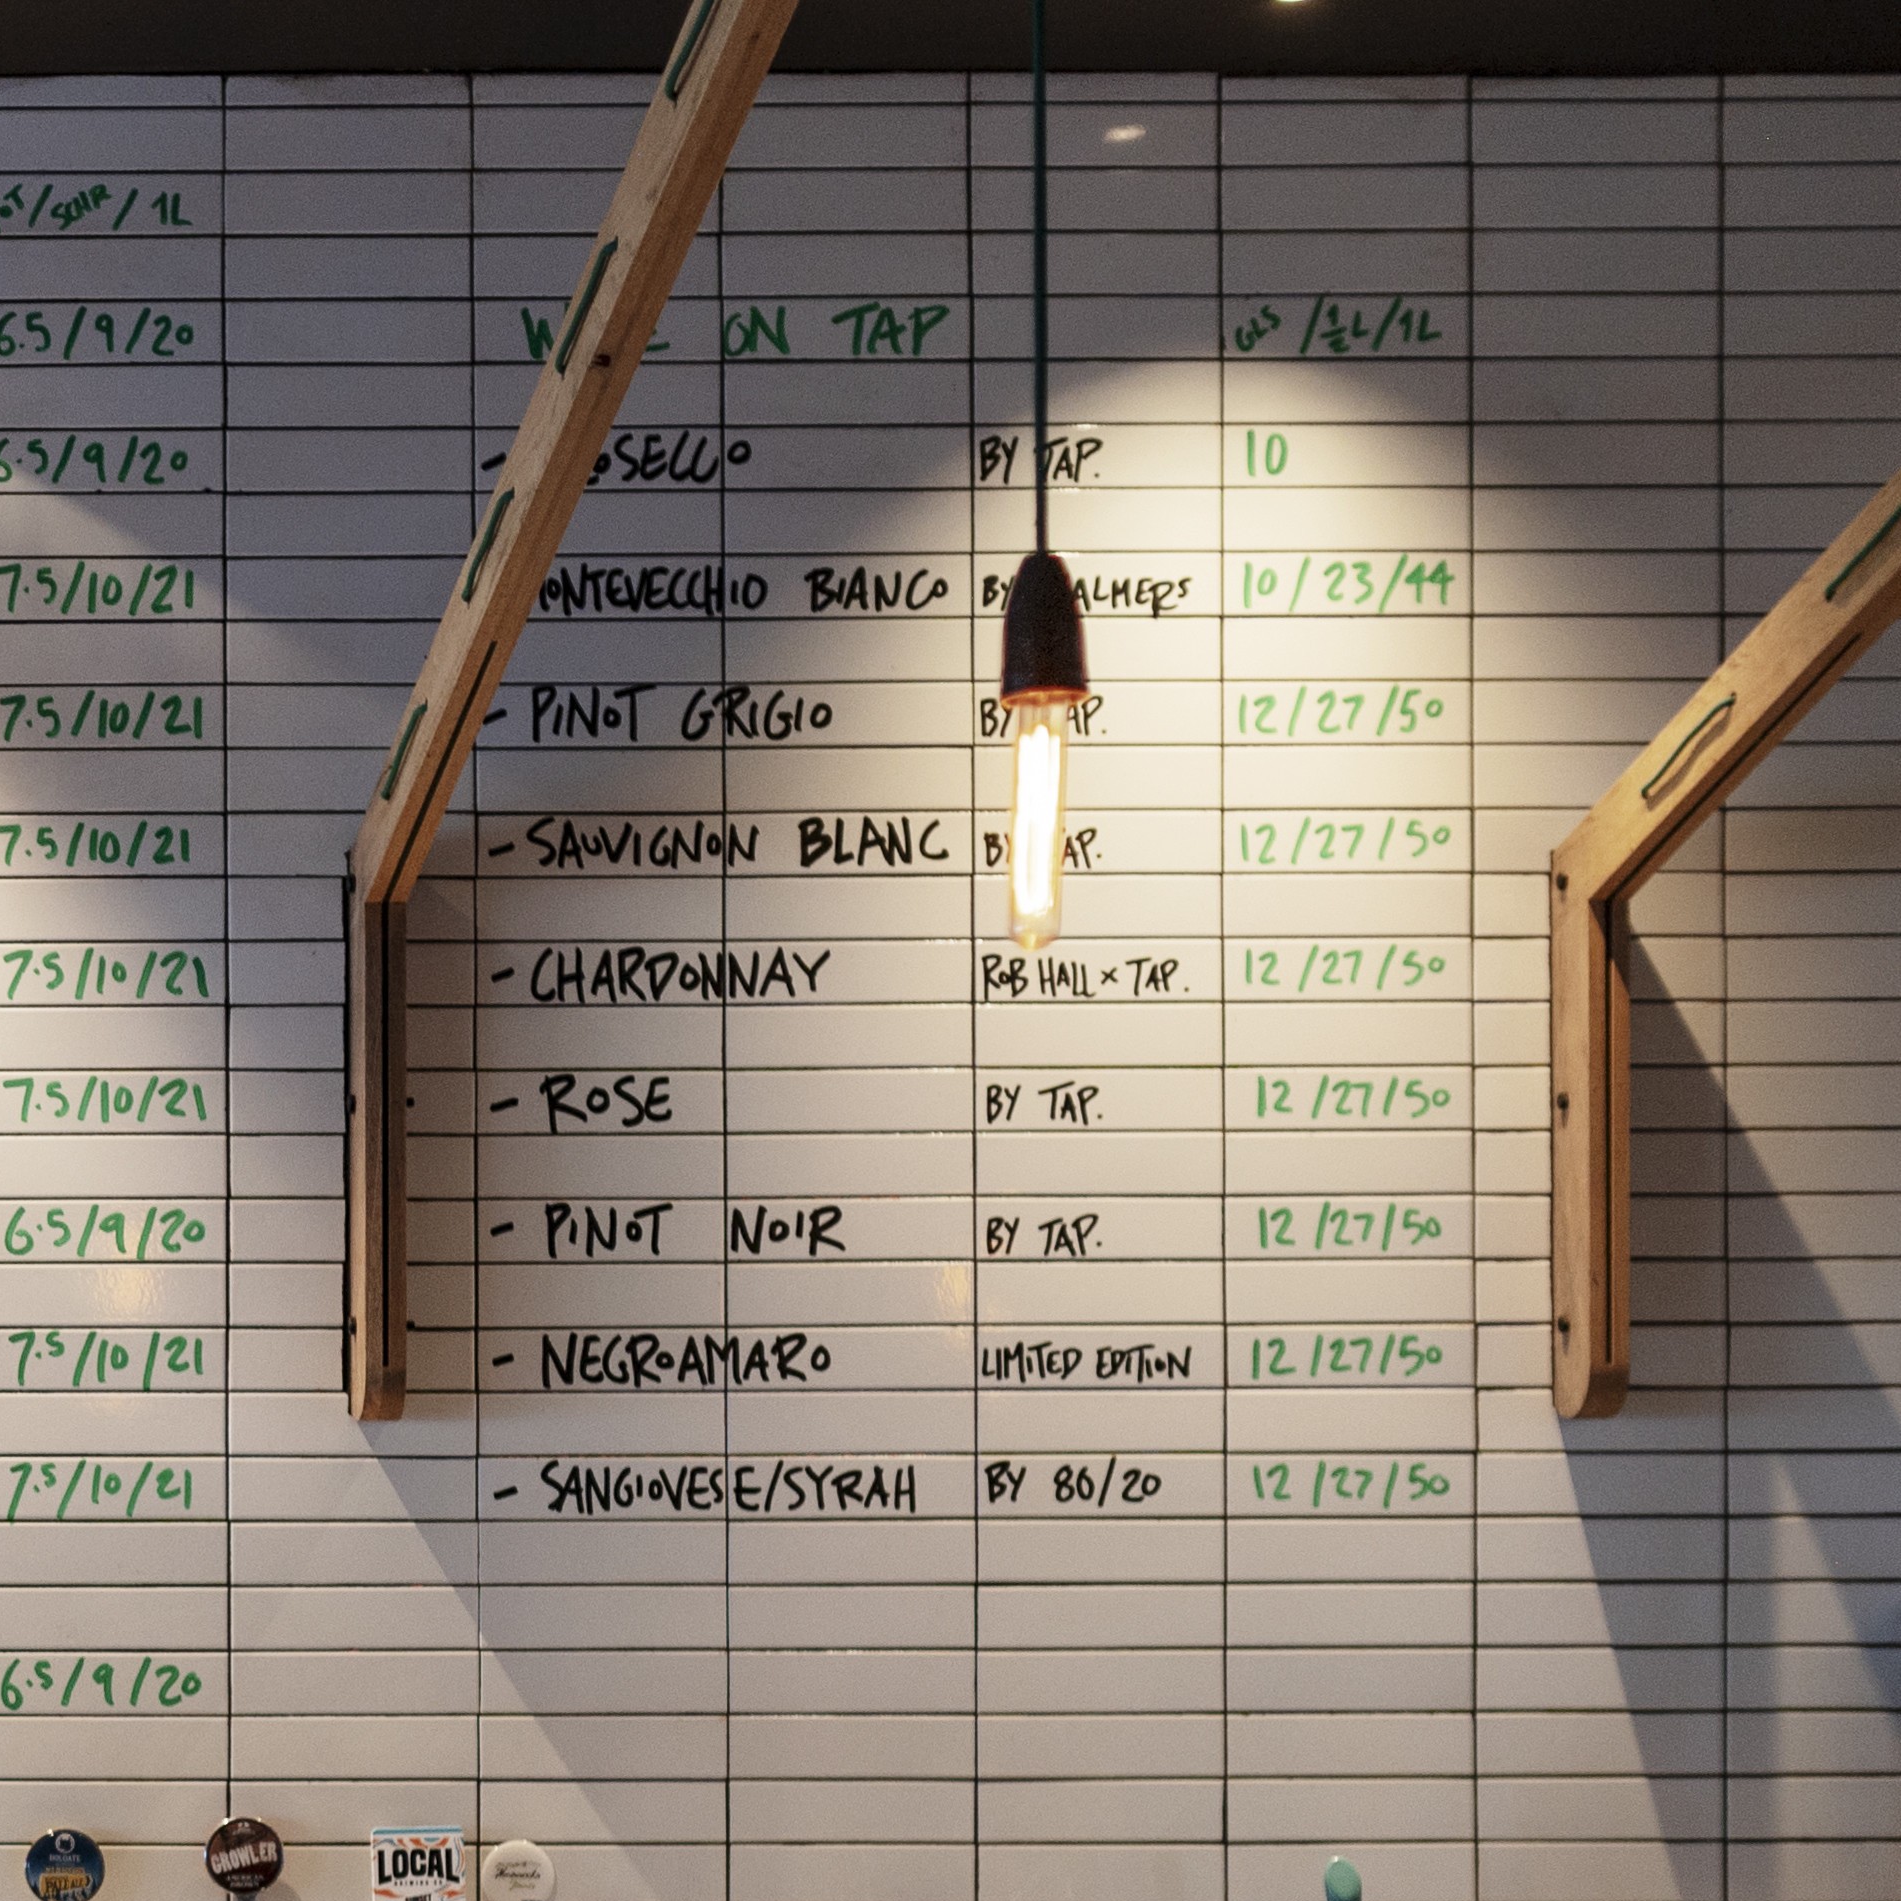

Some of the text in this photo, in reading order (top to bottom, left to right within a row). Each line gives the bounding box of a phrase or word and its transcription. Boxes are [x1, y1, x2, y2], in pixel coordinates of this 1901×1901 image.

[724, 306, 790, 356] ON
[832, 303, 950, 356] TAP
[980, 436, 1019, 484] BY
[1246, 430, 1287, 476] 10
[805, 566, 948, 612] BIANCO
[531, 683, 833, 743] PINOT GRIGIO
[527, 815, 949, 869] SAUVIGNON BLANC
[528, 950, 832, 1003] CHARDONNAY
[982, 955, 1027, 1000] ROB
[1038, 958, 1095, 997] HALL
[541, 1073, 673, 1127] ROSE
[985, 1082, 1102, 1125] BY TAP.
[545, 1202, 846, 1257] PINOT NOIR
[985, 1214, 1102, 1256] BY TAP.
[542, 1332, 831, 1388] NEGROAMARO
[982, 1341, 1192, 1383] LIMITED EDITION
[541, 1460, 916, 1514] SANGIOVESE/SYRAH
[984, 1461, 1027, 1502] BY
[210, 1841, 278, 1875] GROWLER
[377, 1848, 460, 1885] LOCAL
